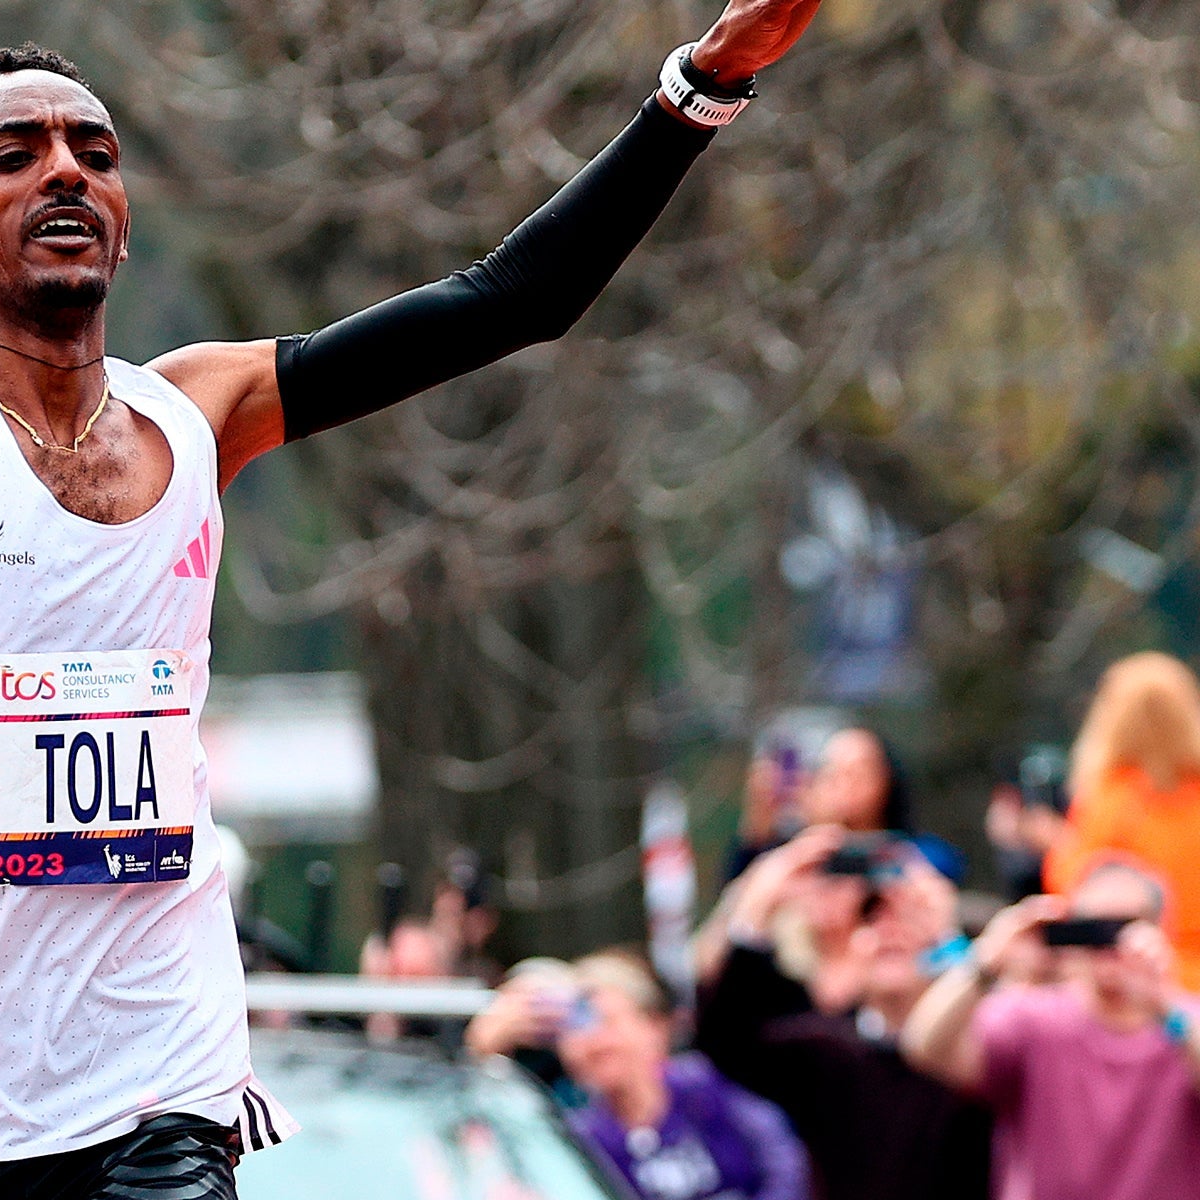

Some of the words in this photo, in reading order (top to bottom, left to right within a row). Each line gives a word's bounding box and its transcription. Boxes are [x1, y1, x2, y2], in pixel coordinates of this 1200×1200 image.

[62, 662, 93, 672] TATA
[1, 666, 56, 701] tcs
[62, 673, 136, 687] CONSULTANCY
[63, 688, 110, 700] SERVICES
[151, 684, 174, 696] TATA
[35, 730, 159, 824] TOLA
